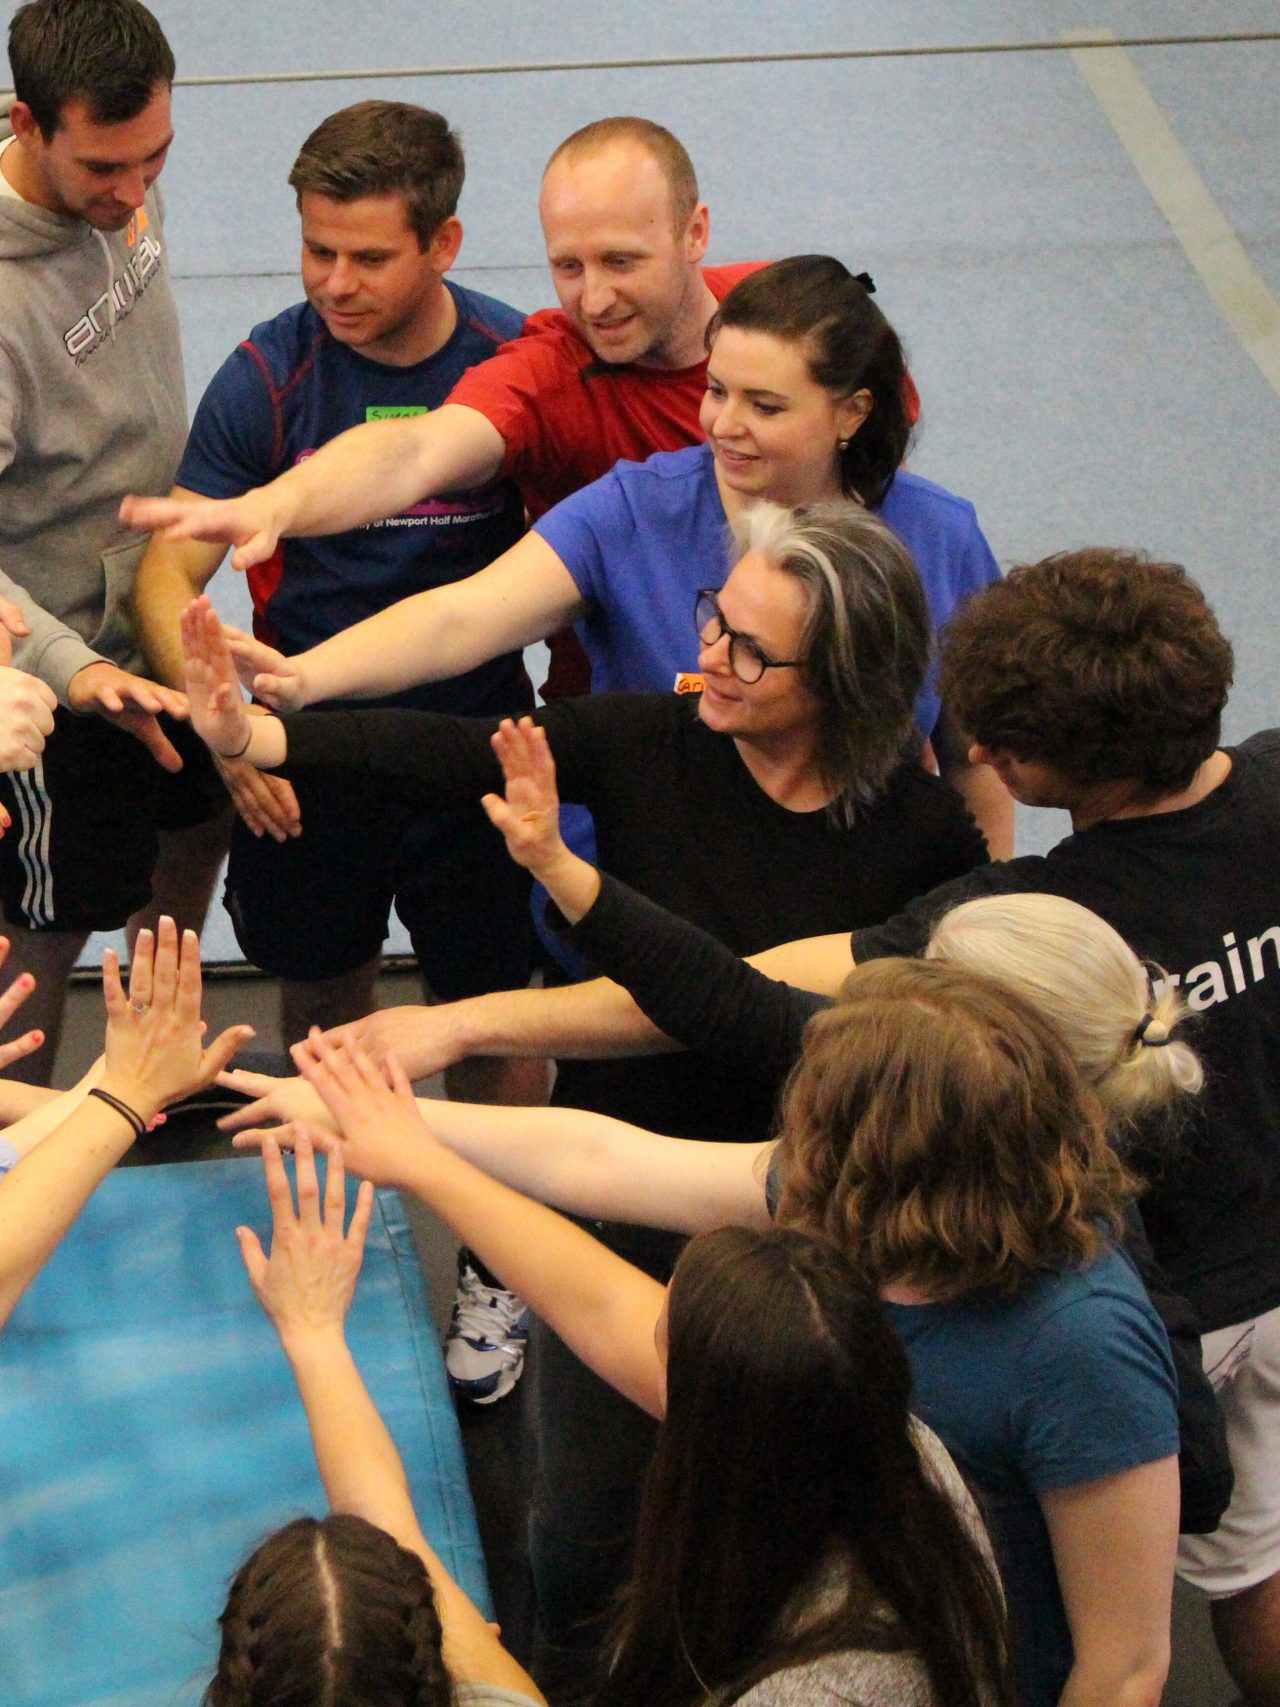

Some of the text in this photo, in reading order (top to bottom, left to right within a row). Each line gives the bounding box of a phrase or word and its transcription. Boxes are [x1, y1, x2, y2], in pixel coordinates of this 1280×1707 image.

[386, 516, 428, 528] Newport
[430, 516, 451, 526] Half
[1143, 926, 1280, 1011] rain
